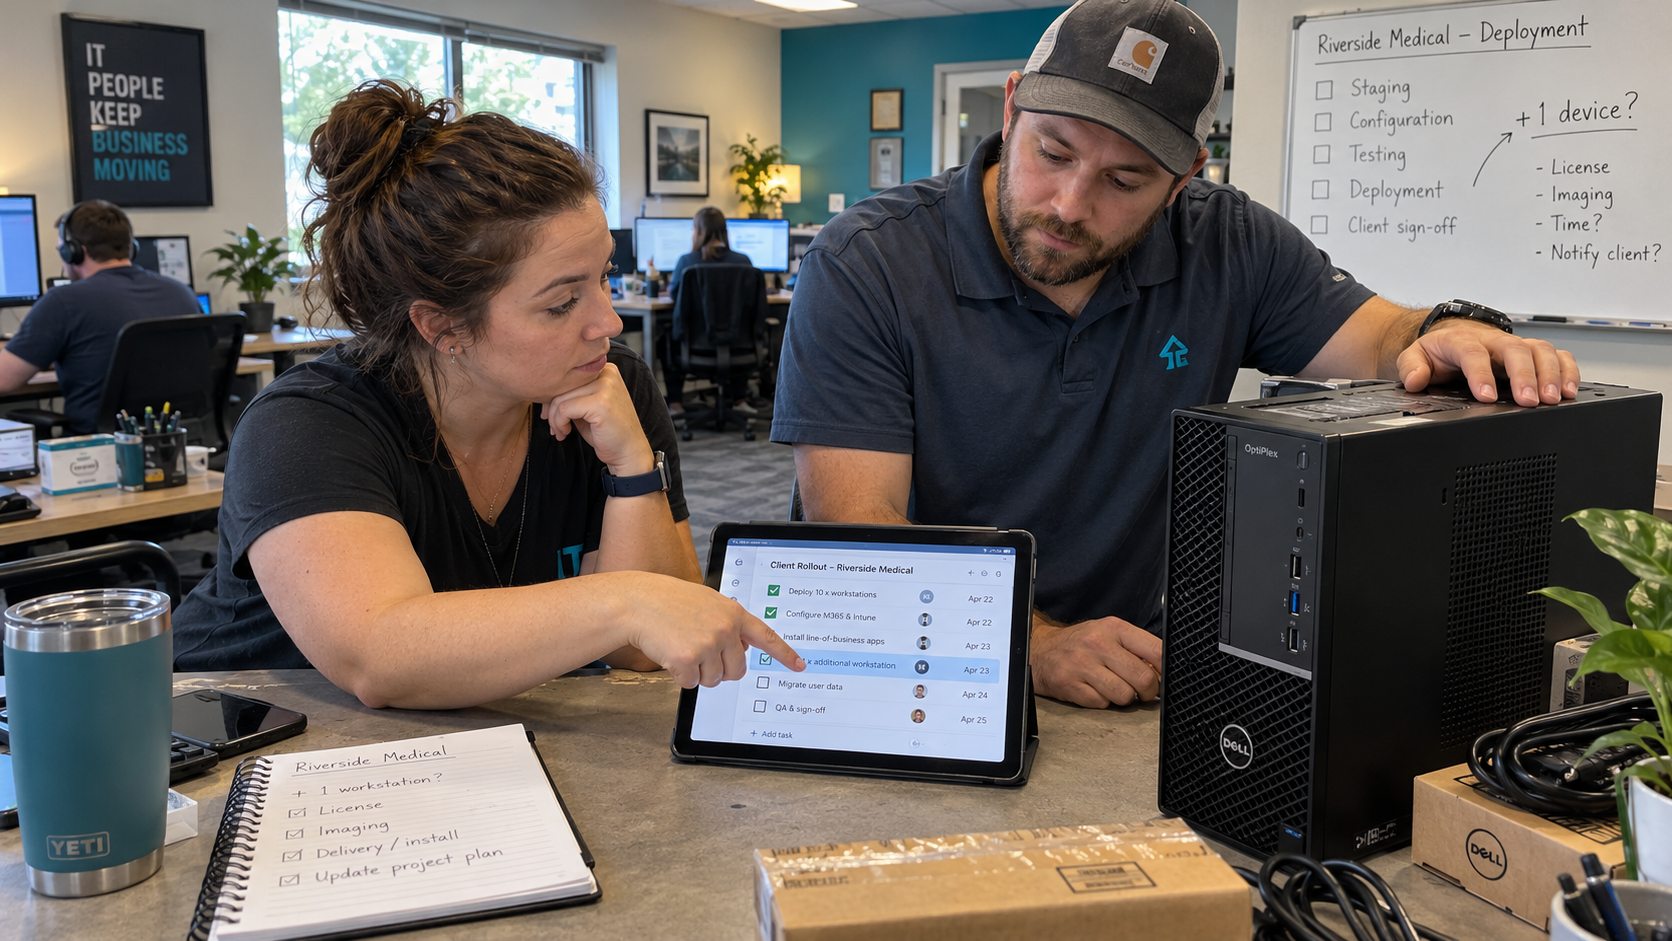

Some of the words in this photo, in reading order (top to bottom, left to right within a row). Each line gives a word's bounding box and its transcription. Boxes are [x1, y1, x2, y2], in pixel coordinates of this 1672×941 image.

[1318, 31, 1382, 54] Riverside
[1390, 24, 1450, 49] Medical
[1481, 15, 1589, 50] Deployment
[86, 42, 105, 67] IT
[88, 71, 165, 100] PEOPLE
[1351, 78, 1410, 104] Staging
[90, 101, 142, 126] KEEP
[1559, 91, 1639, 123] device?
[1350, 109, 1453, 136] Configuration
[92, 130, 188, 155] BUSINESS
[1349, 144, 1406, 171] Testing
[1552, 158, 1611, 175] License
[93, 158, 170, 181] MOVING
[1350, 179, 1444, 207] Deployment
[1552, 185, 1613, 209] Imaging
[1348, 216, 1389, 234] Client
[1397, 216, 1457, 242] sign-off
[1551, 213, 1603, 232] Time?
[1551, 243, 1600, 269] Notify
[1608, 243, 1662, 263] client?
[1245, 443, 1278, 458] OptiPlex
[770, 561, 795, 570] Client
[797, 562, 827, 571] Rollout
[836, 563, 877, 573] Riverside
[879, 565, 914, 575] Medical
[788, 587, 814, 597] Deploy
[831, 589, 877, 598] workstations
[968, 595, 982, 603] Apr
[786, 610, 822, 620] Configure
[823, 611, 844, 620] M365
[853, 613, 876, 622] Intune
[966, 618, 980, 627] Apr
[783, 633, 805, 641] Install
[806, 634, 865, 644] line-of-business
[866, 638, 885, 647] apps
[965, 642, 979, 651] Apr
[980, 643, 991, 651] 23
[813, 658, 851, 667] additional
[852, 661, 896, 670] workstation
[963, 666, 978, 675] Apr
[979, 667, 990, 675] 23
[778, 680, 807, 689] Migrate
[826, 683, 843, 691] data
[962, 691, 976, 699] Apr
[978, 691, 988, 699] 24
[775, 704, 787, 712] QA
[789, 704, 794, 712] &
[796, 706, 826, 715] sign-off
[960, 716, 975, 724] Apr
[976, 716, 987, 724] 25
[761, 730, 777, 738] Add
[778, 731, 793, 739] task
[1223, 737, 1250, 757] DELL
[295, 757, 371, 772] Riverside
[384, 745, 447, 763] Medical
[320, 786, 328, 796] 1
[339, 772, 443, 793] workstation?
[319, 801, 384, 815] License
[319, 821, 389, 837] Imaging
[51, 837, 103, 856] YETI
[317, 843, 383, 860] Delivery
[405, 829, 459, 847] install
[1471, 842, 1503, 867] DELL
[315, 865, 380, 885] Update
[391, 854, 454, 877] project
[465, 848, 504, 866] plan
